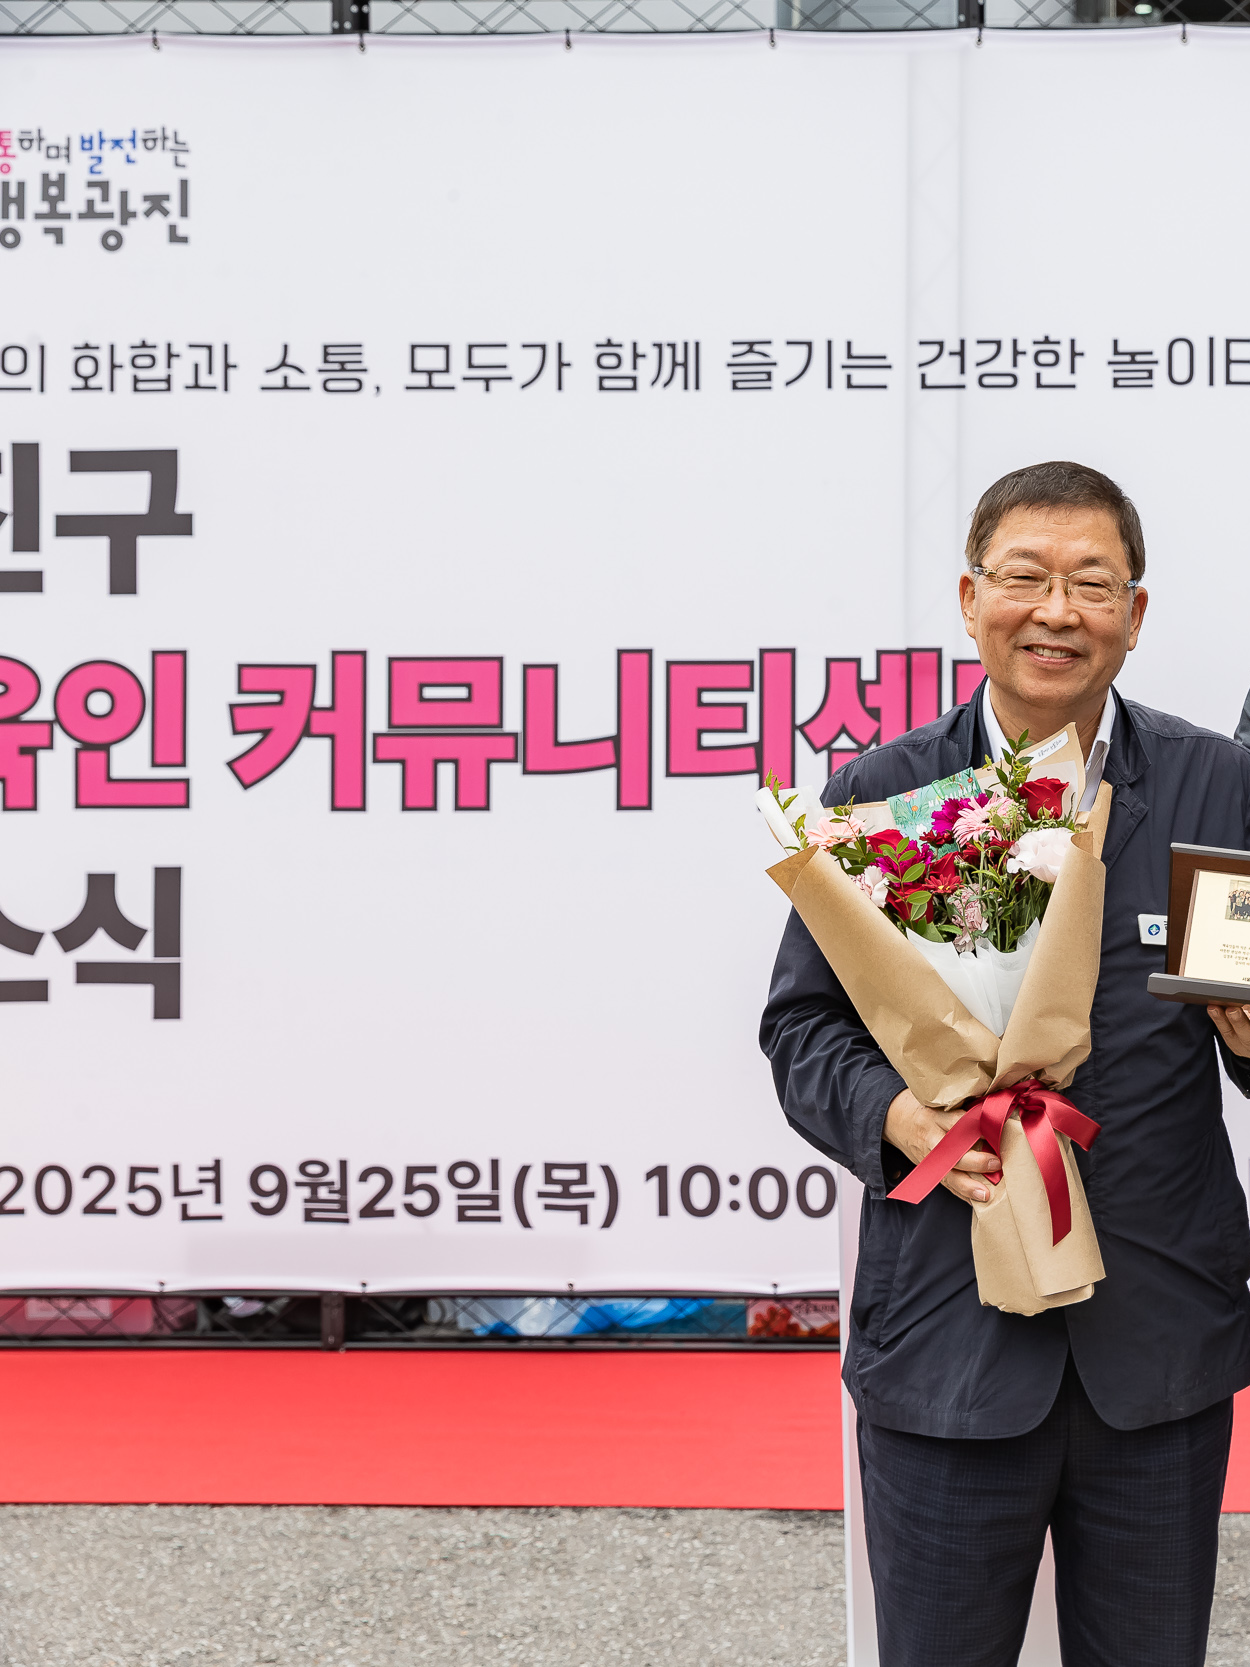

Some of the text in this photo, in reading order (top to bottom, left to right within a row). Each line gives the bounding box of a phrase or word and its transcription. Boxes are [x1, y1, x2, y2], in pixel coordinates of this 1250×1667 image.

[80, 126, 190, 175] 발전하는
[70, 339, 238, 393] 화합과
[259, 342, 381, 396] 소통,
[404, 341, 572, 393] 모두가
[594, 337, 701, 392] 함께
[726, 339, 893, 391] 즐기는
[917, 335, 1085, 390] 건강한
[225, 647, 985, 813] 커뮤니티센
[0, 1158, 837, 1230] 2025년 9월25일(목) 10:00
